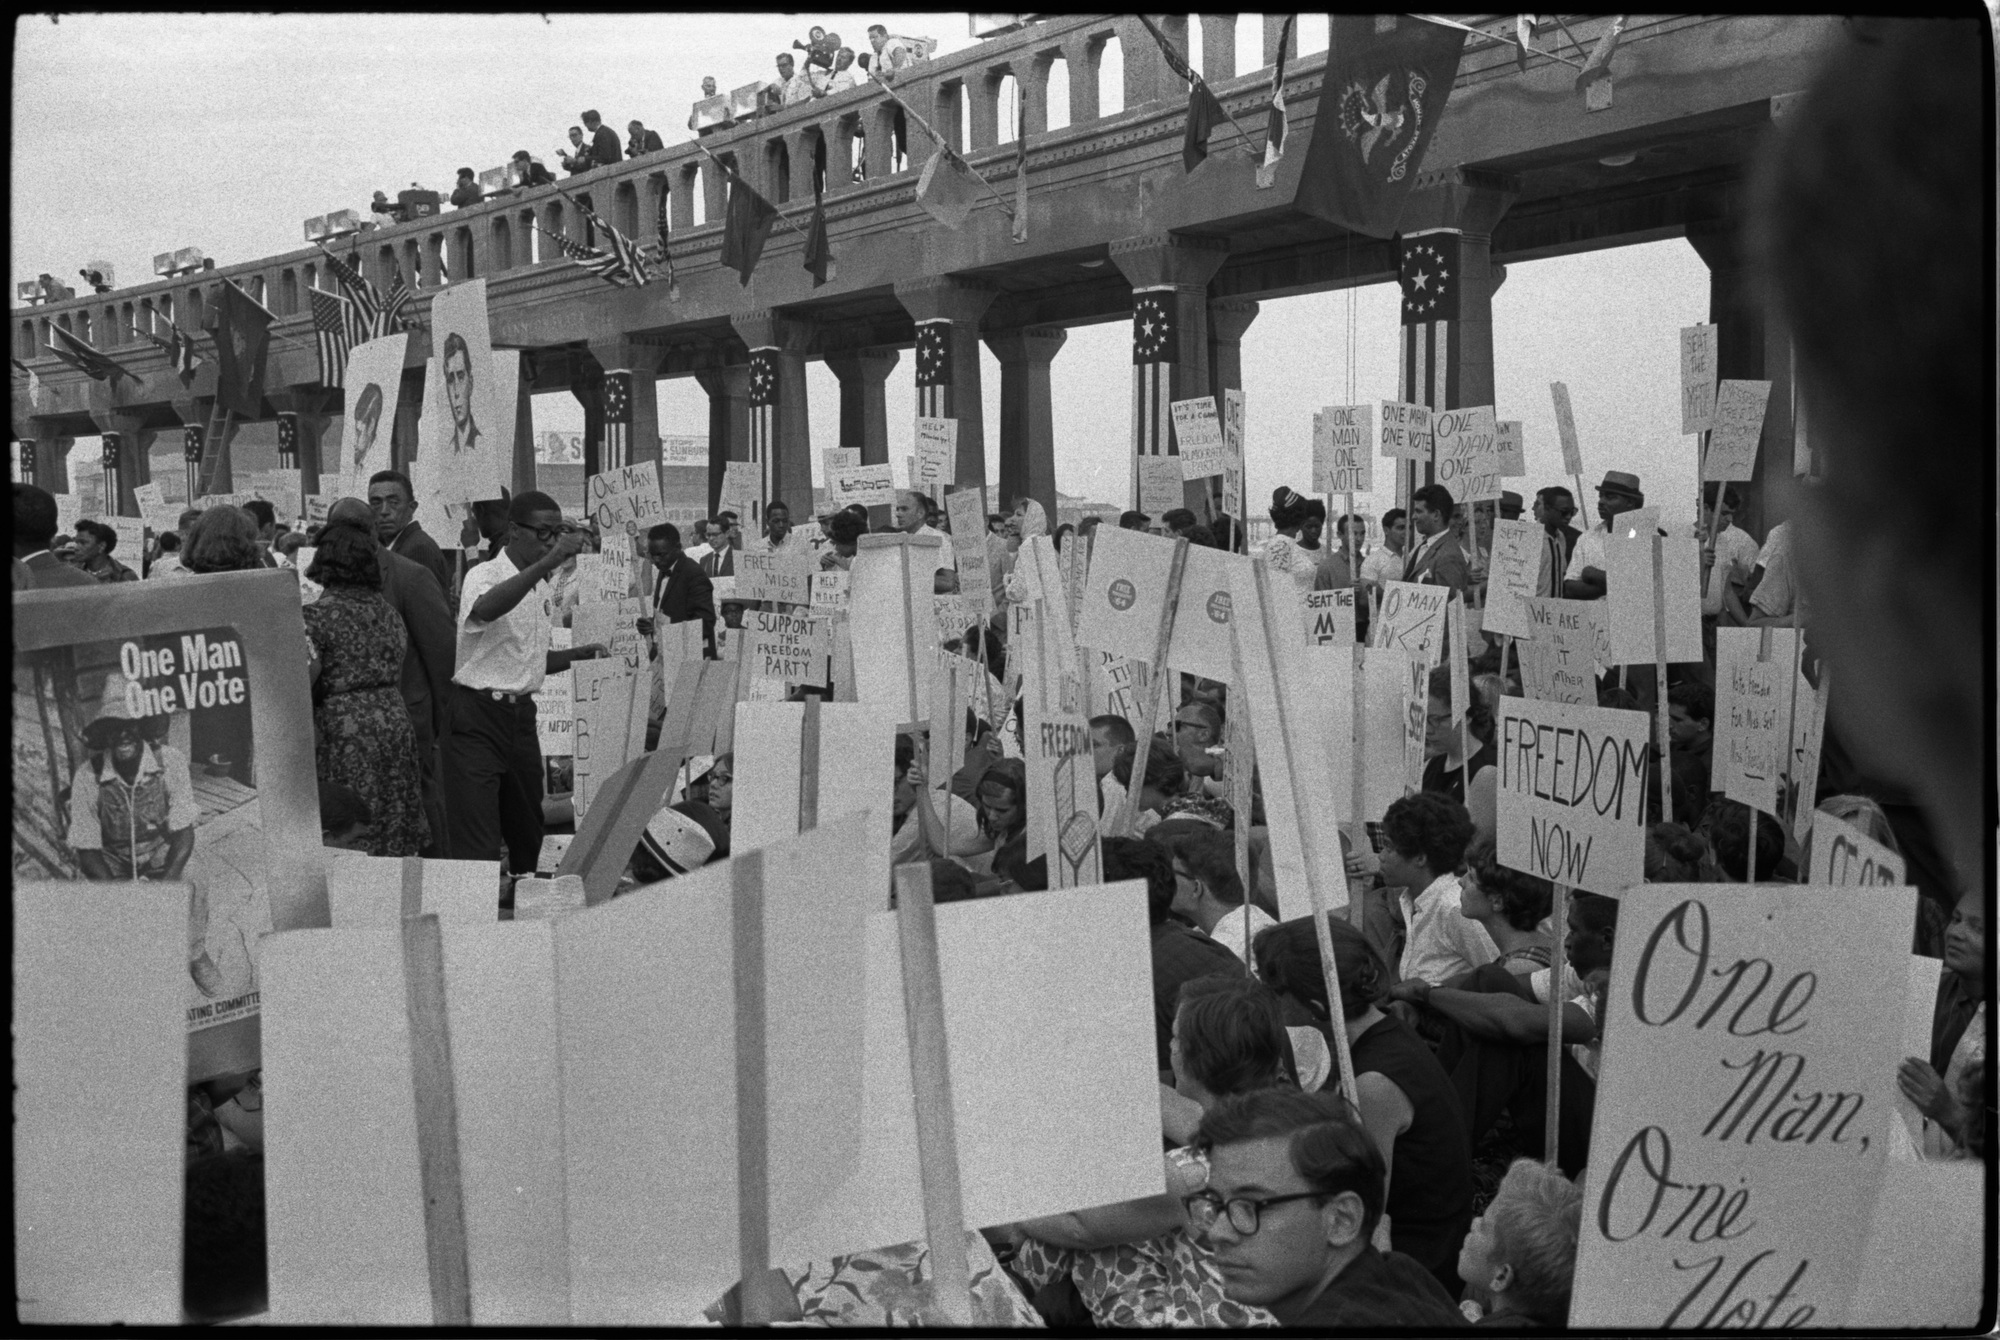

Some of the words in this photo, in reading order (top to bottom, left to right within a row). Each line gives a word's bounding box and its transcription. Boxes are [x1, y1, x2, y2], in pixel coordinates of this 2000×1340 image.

[1335, 409, 1356, 426] ONE
[1383, 405, 1405, 423] ONE
[1409, 408, 1427, 426] MAN
[1438, 412, 1478, 438] ONE
[1332, 428, 1359, 446] MAN
[1382, 427, 1404, 446] ONE
[1409, 430, 1432, 452] VOTE
[1335, 447, 1357, 467] ONE
[1441, 456, 1476, 480] ONE
[594, 475, 619, 498] ONE
[622, 467, 651, 490] MAN
[1330, 468, 1364, 490] VOTE
[1461, 473, 1501, 502] VOTE
[599, 503, 625, 529] ONE
[629, 494, 659, 519] VOTE
[744, 555, 776, 570] FREE
[765, 573, 797, 588] MISS
[753, 588, 766, 599] IN
[1307, 594, 1333, 608] SEAT
[1334, 591, 1353, 607] THE
[1407, 592, 1443, 612] MAN
[757, 612, 817, 636] SUPPORT
[1530, 604, 1553, 626] WE
[1559, 613, 1580, 631] ARE
[757, 643, 812, 657] FREEDOM
[779, 634, 800, 645] THE
[1553, 633, 1565, 646] IN
[121, 641, 175, 680] One
[181, 634, 242, 673] Man
[765, 656, 811, 677] PARTY
[1557, 649, 1570, 666] IT
[125, 681, 176, 719] One
[178, 670, 245, 710] Vote
[1041, 722, 1092, 758] FREEDOM
[1503, 716, 1649, 827] FREEDOM
[1531, 815, 1593, 884] NOW
[1632, 898, 1818, 1037] One
[1701, 1048, 1872, 1156] Man,
[1596, 1124, 1758, 1243] One
[1662, 1248, 1818, 1329] Vote
